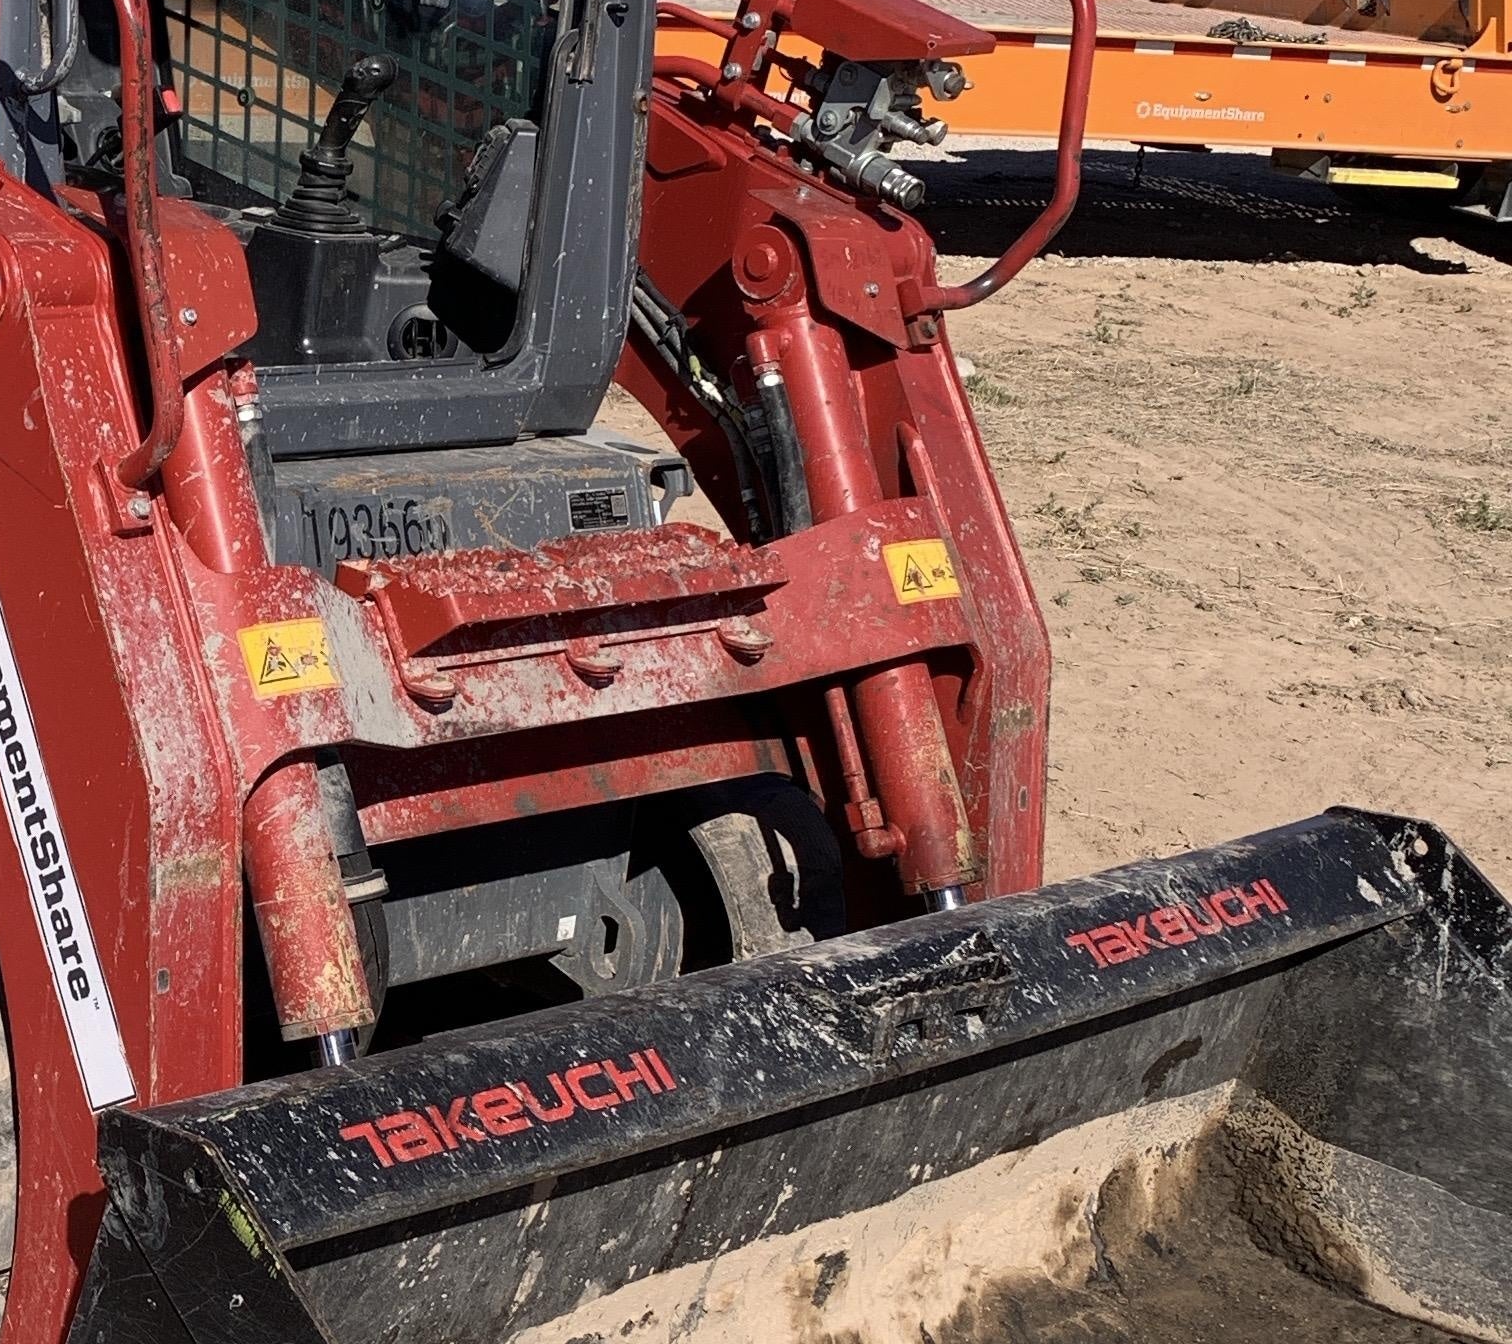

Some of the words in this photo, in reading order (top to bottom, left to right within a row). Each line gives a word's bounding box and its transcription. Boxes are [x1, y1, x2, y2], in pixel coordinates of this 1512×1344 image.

[1152, 103, 1265, 122] EquipmentShare
[1064, 877, 1289, 969] TAKEUCHI
[338, 1048, 678, 1168] TAKEUCHI
